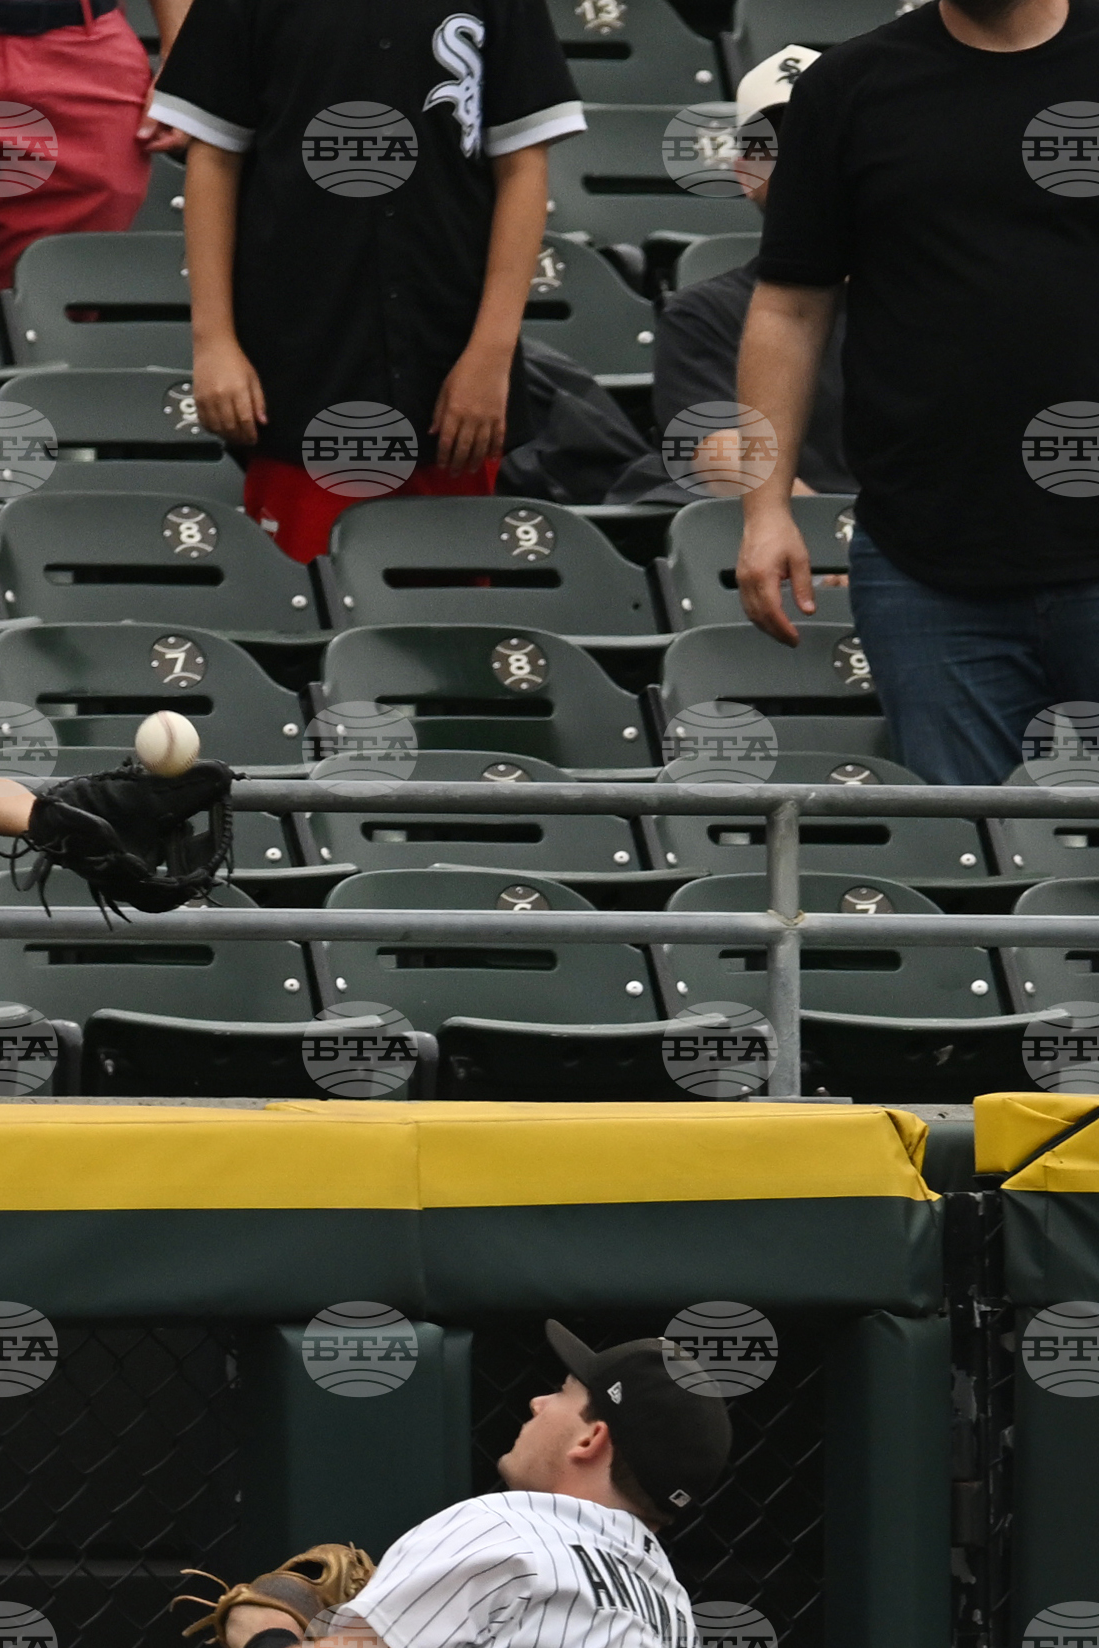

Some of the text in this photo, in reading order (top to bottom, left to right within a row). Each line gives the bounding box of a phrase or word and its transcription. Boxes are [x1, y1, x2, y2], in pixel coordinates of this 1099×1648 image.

[698, 134, 738, 158] 12
[179, 522, 201, 544] 8
[516, 526, 538, 547] 9
[165, 652, 187, 674] 7
[508, 654, 530, 676] 8
[849, 654, 870, 676] 9
